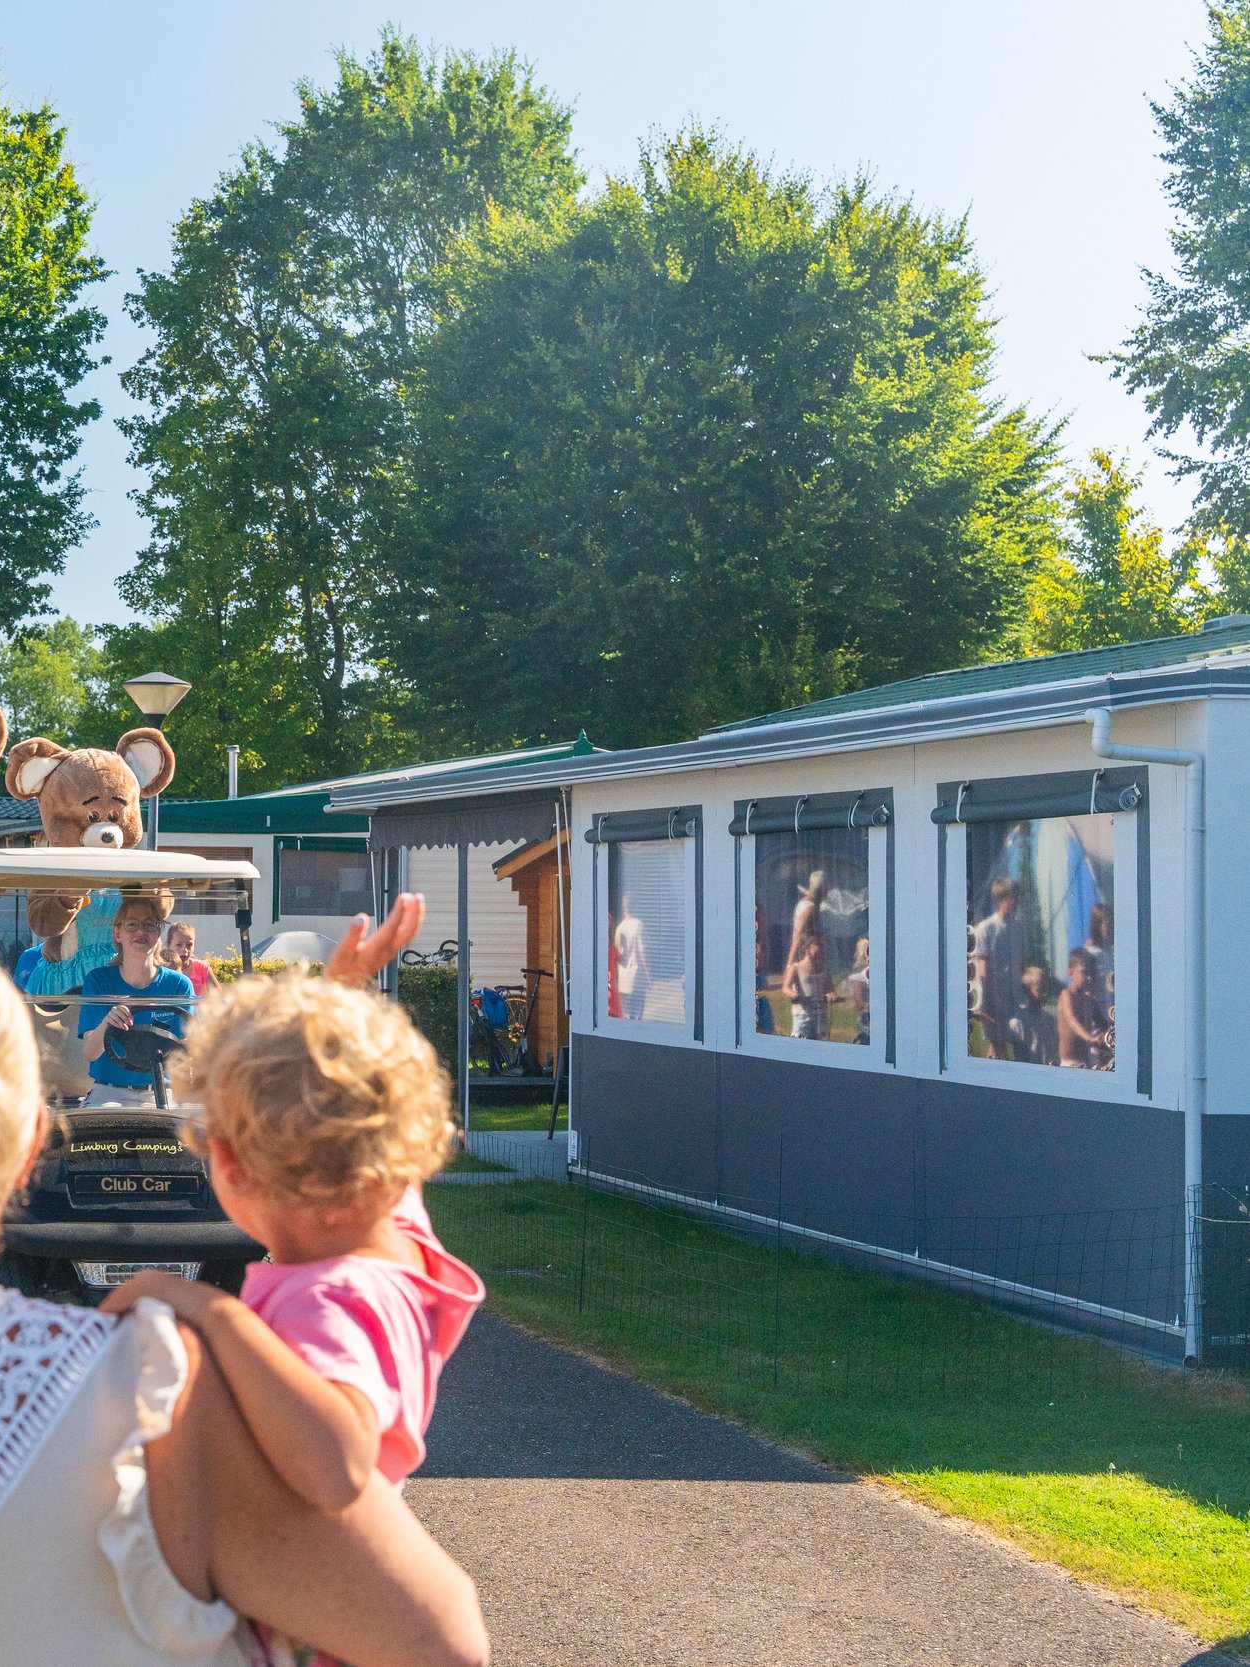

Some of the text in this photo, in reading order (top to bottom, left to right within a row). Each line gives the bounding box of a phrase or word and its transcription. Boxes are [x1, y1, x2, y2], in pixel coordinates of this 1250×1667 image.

[70, 1141, 118, 1154] Limburg
[100, 1177, 171, 1191] Club Car
